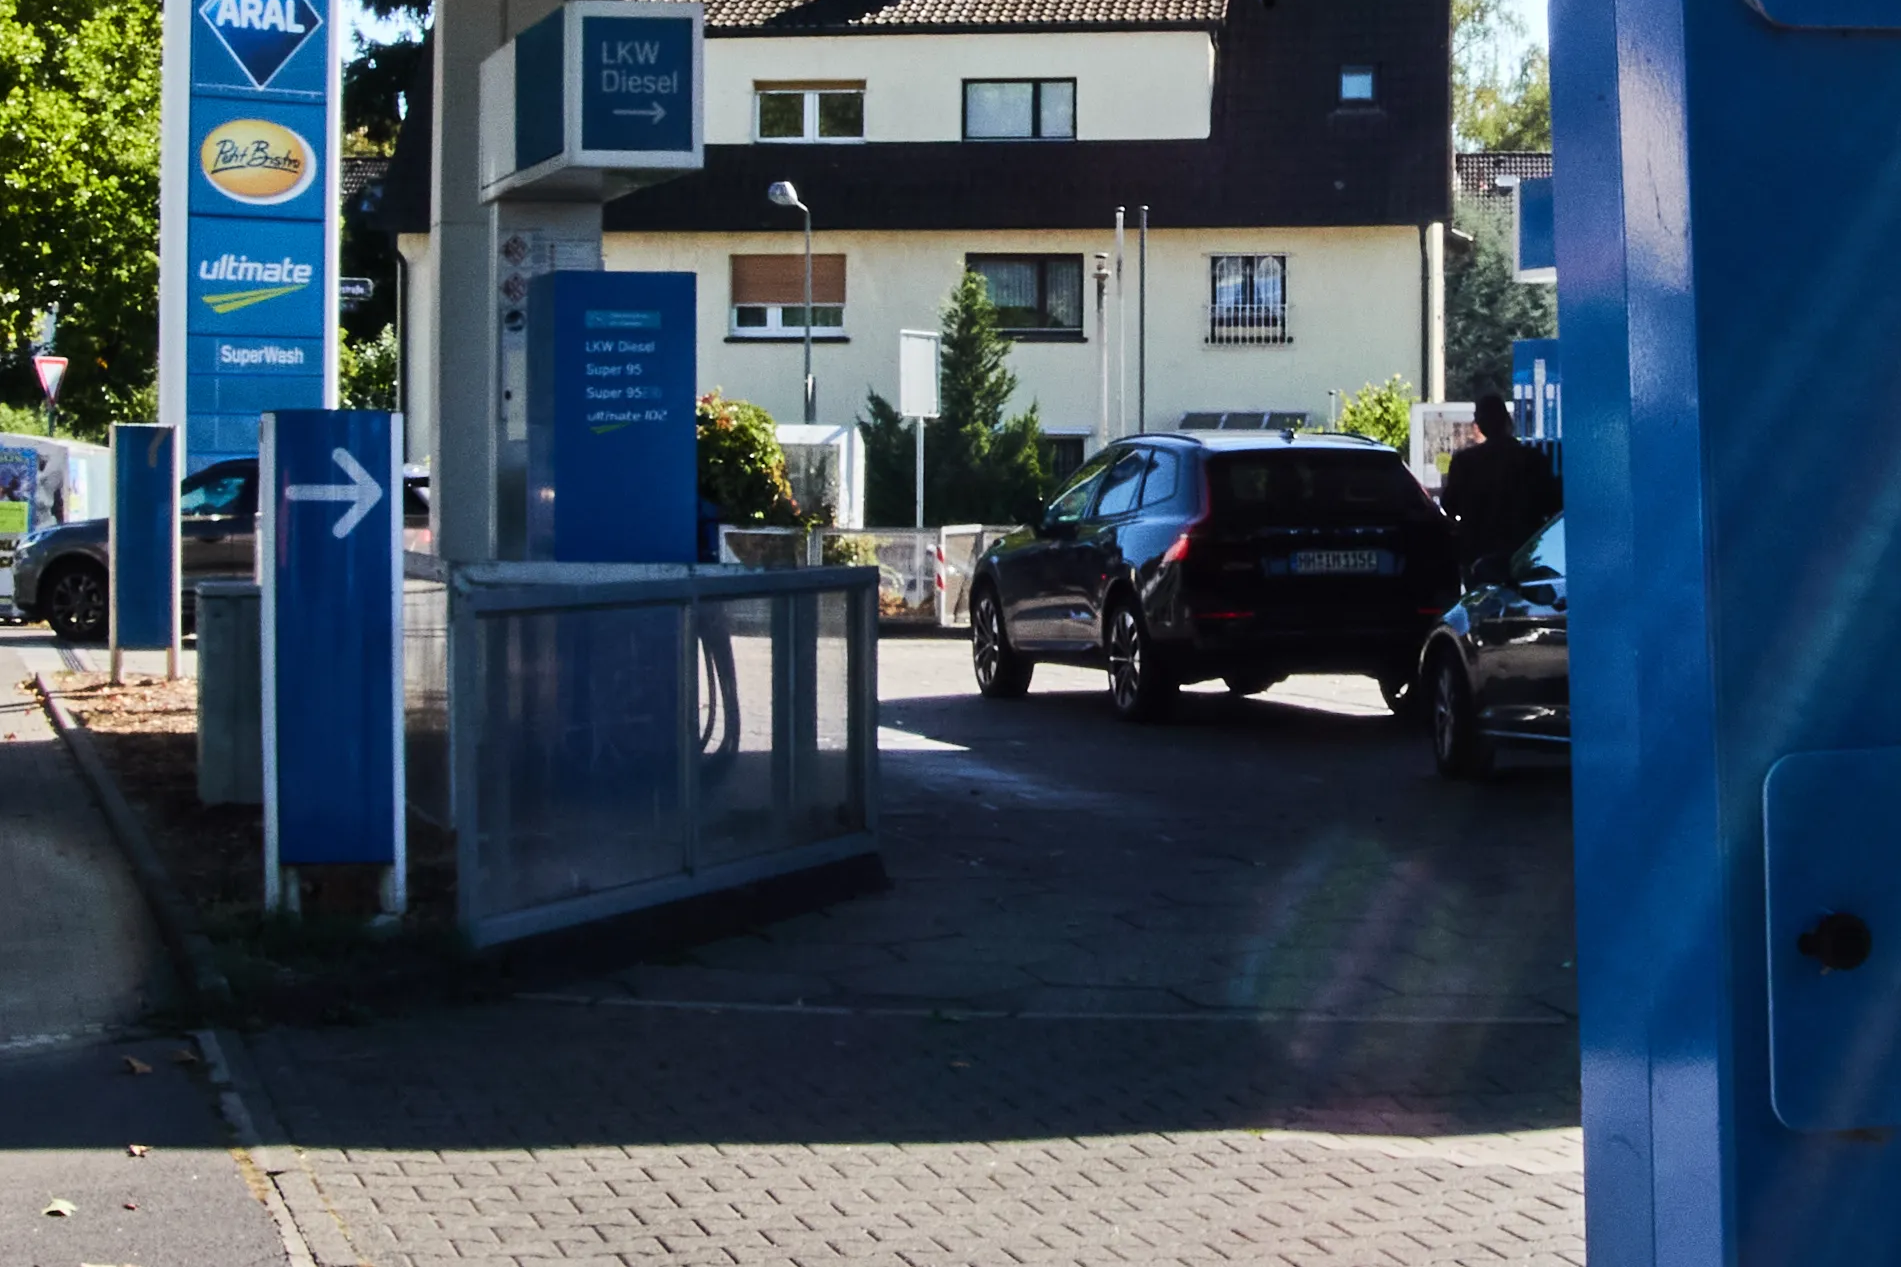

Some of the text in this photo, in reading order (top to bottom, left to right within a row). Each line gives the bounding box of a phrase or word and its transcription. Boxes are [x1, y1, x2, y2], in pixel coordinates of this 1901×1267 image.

[602, 40, 660, 65] LKW
[601, 69, 679, 95] Diesel
[199, 253, 313, 283] ultimate
[220, 344, 304, 367] SuperWash
[585, 340, 656, 353] LKW Diesel
[586, 363, 642, 378] Super 95
[586, 386, 622, 400] Super
[587, 410, 642, 422] ultimate
